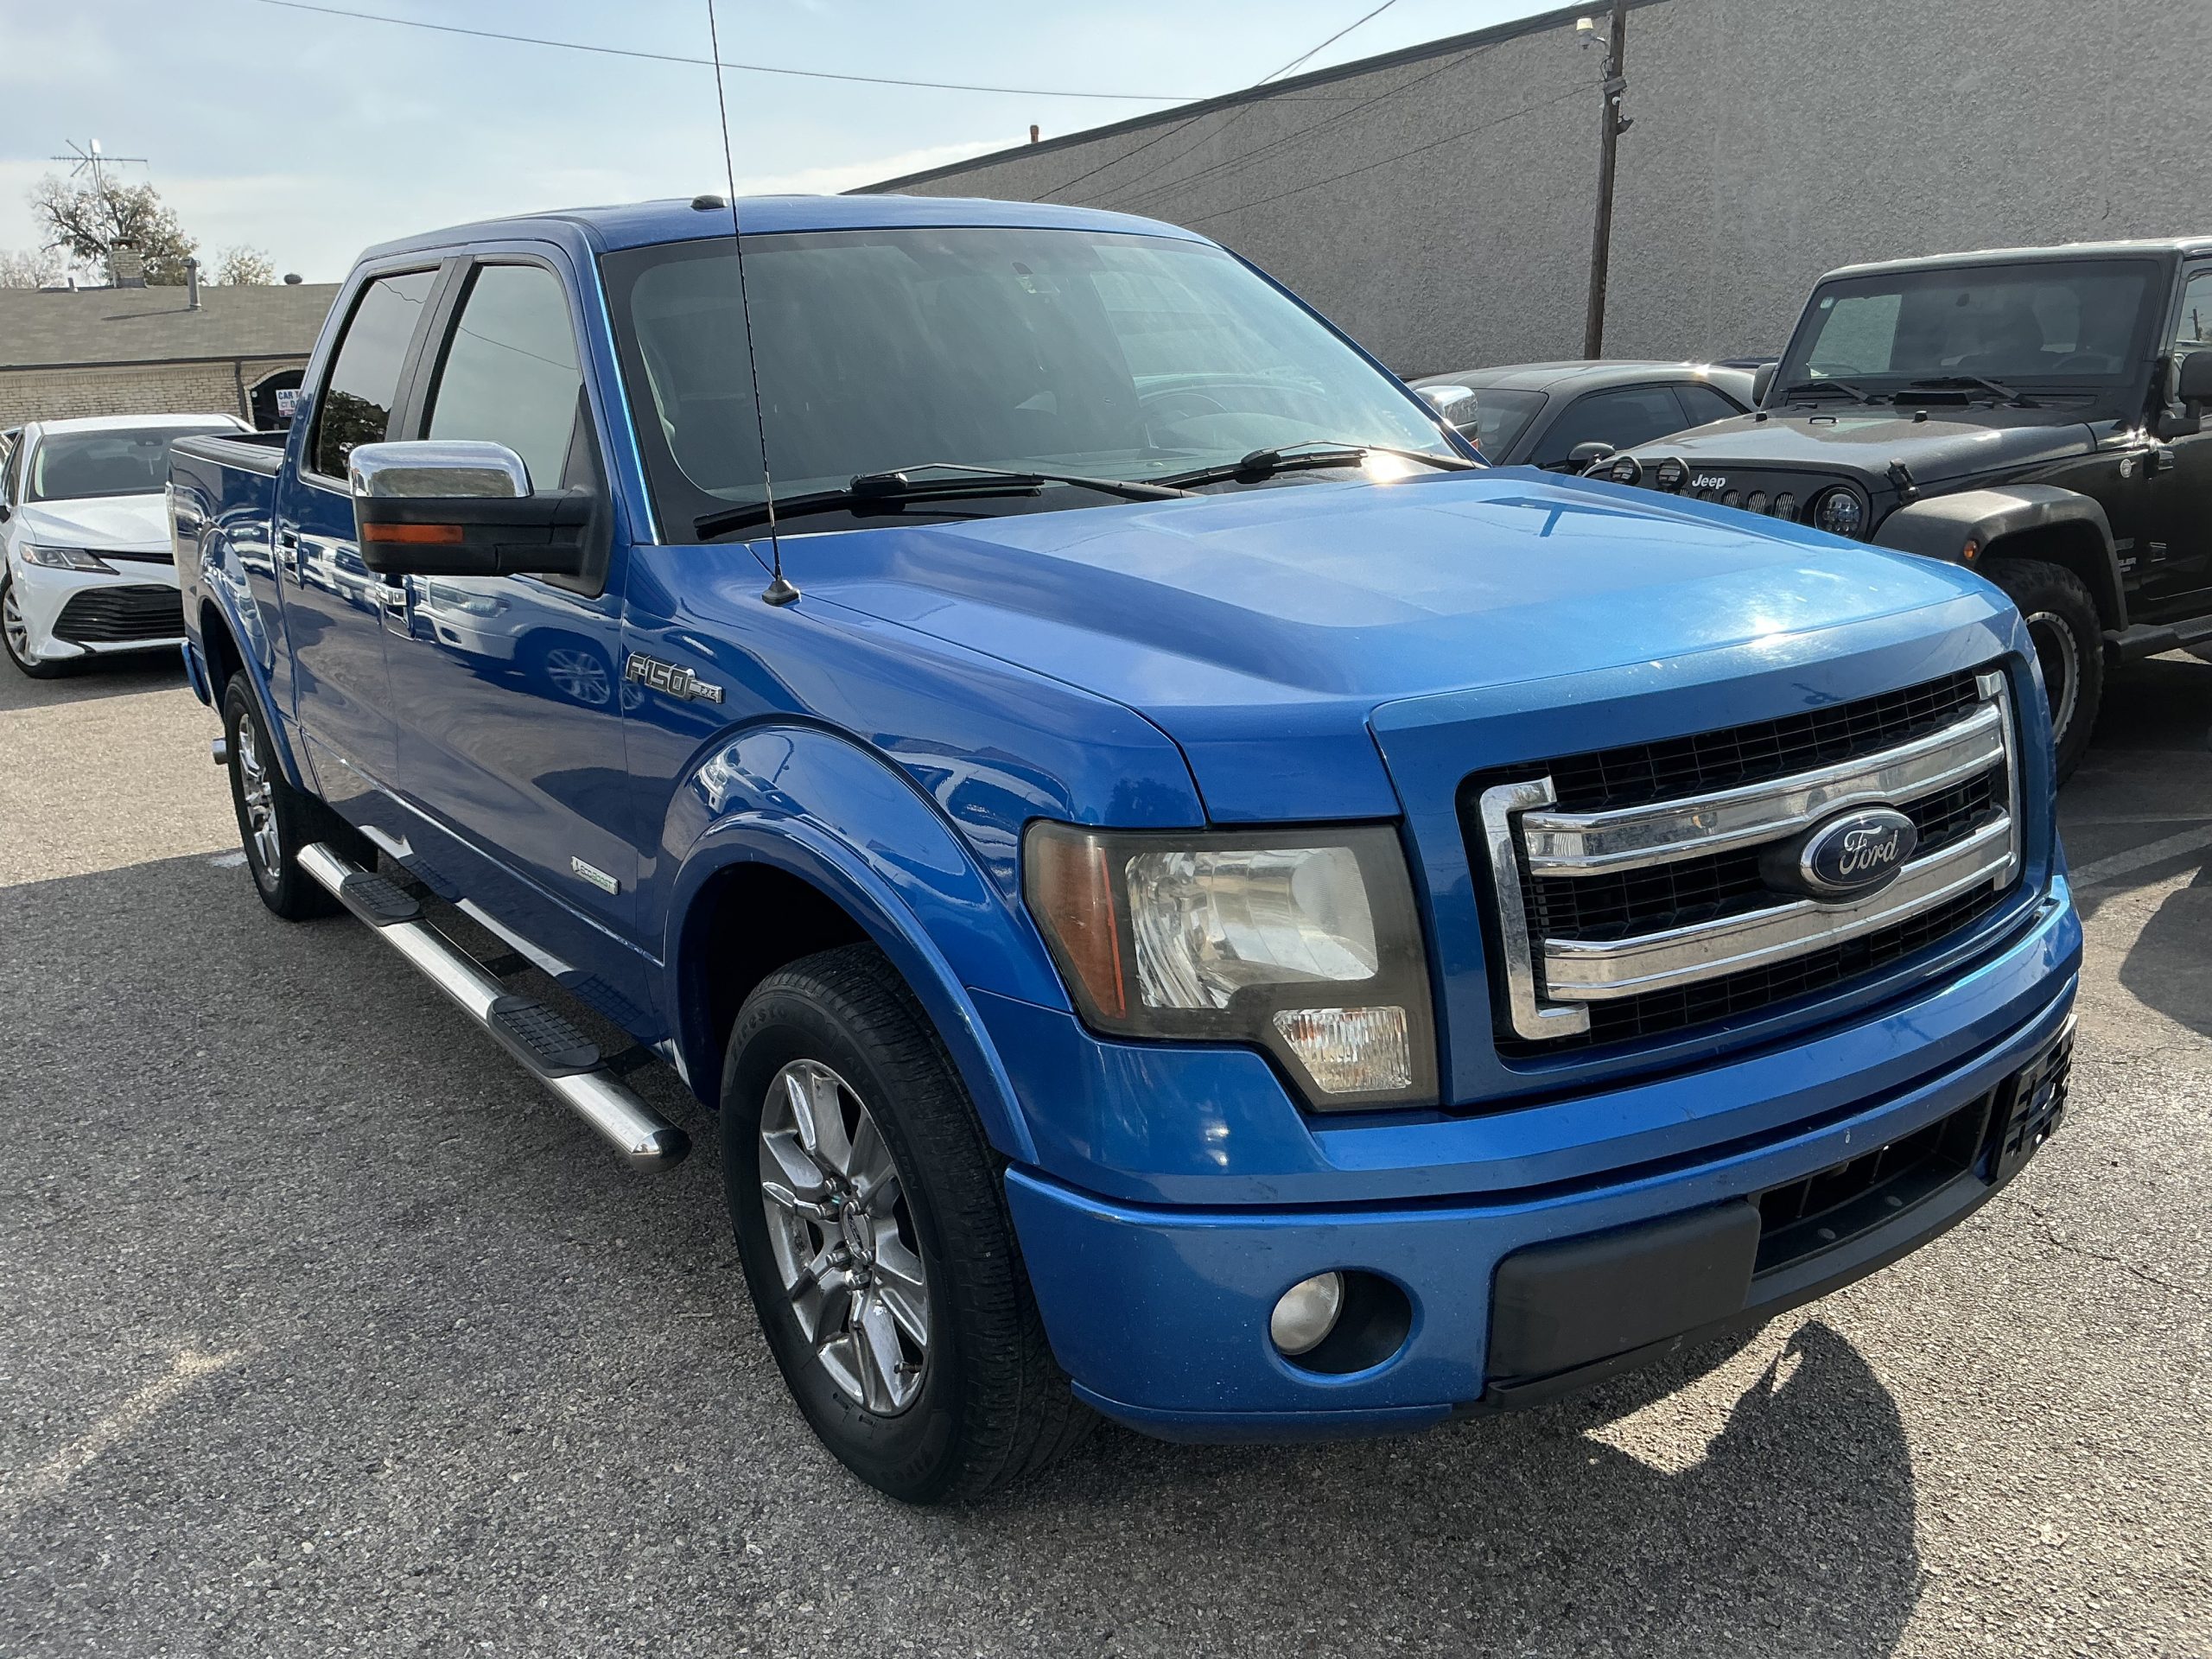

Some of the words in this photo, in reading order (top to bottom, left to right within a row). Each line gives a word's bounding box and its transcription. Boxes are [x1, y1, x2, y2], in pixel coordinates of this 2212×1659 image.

[278, 391, 294, 400] CAR
[1691, 474, 1726, 490] Jeep
[1839, 825, 1899, 875] Ford
[730, 1003, 802, 1061] Firesto
